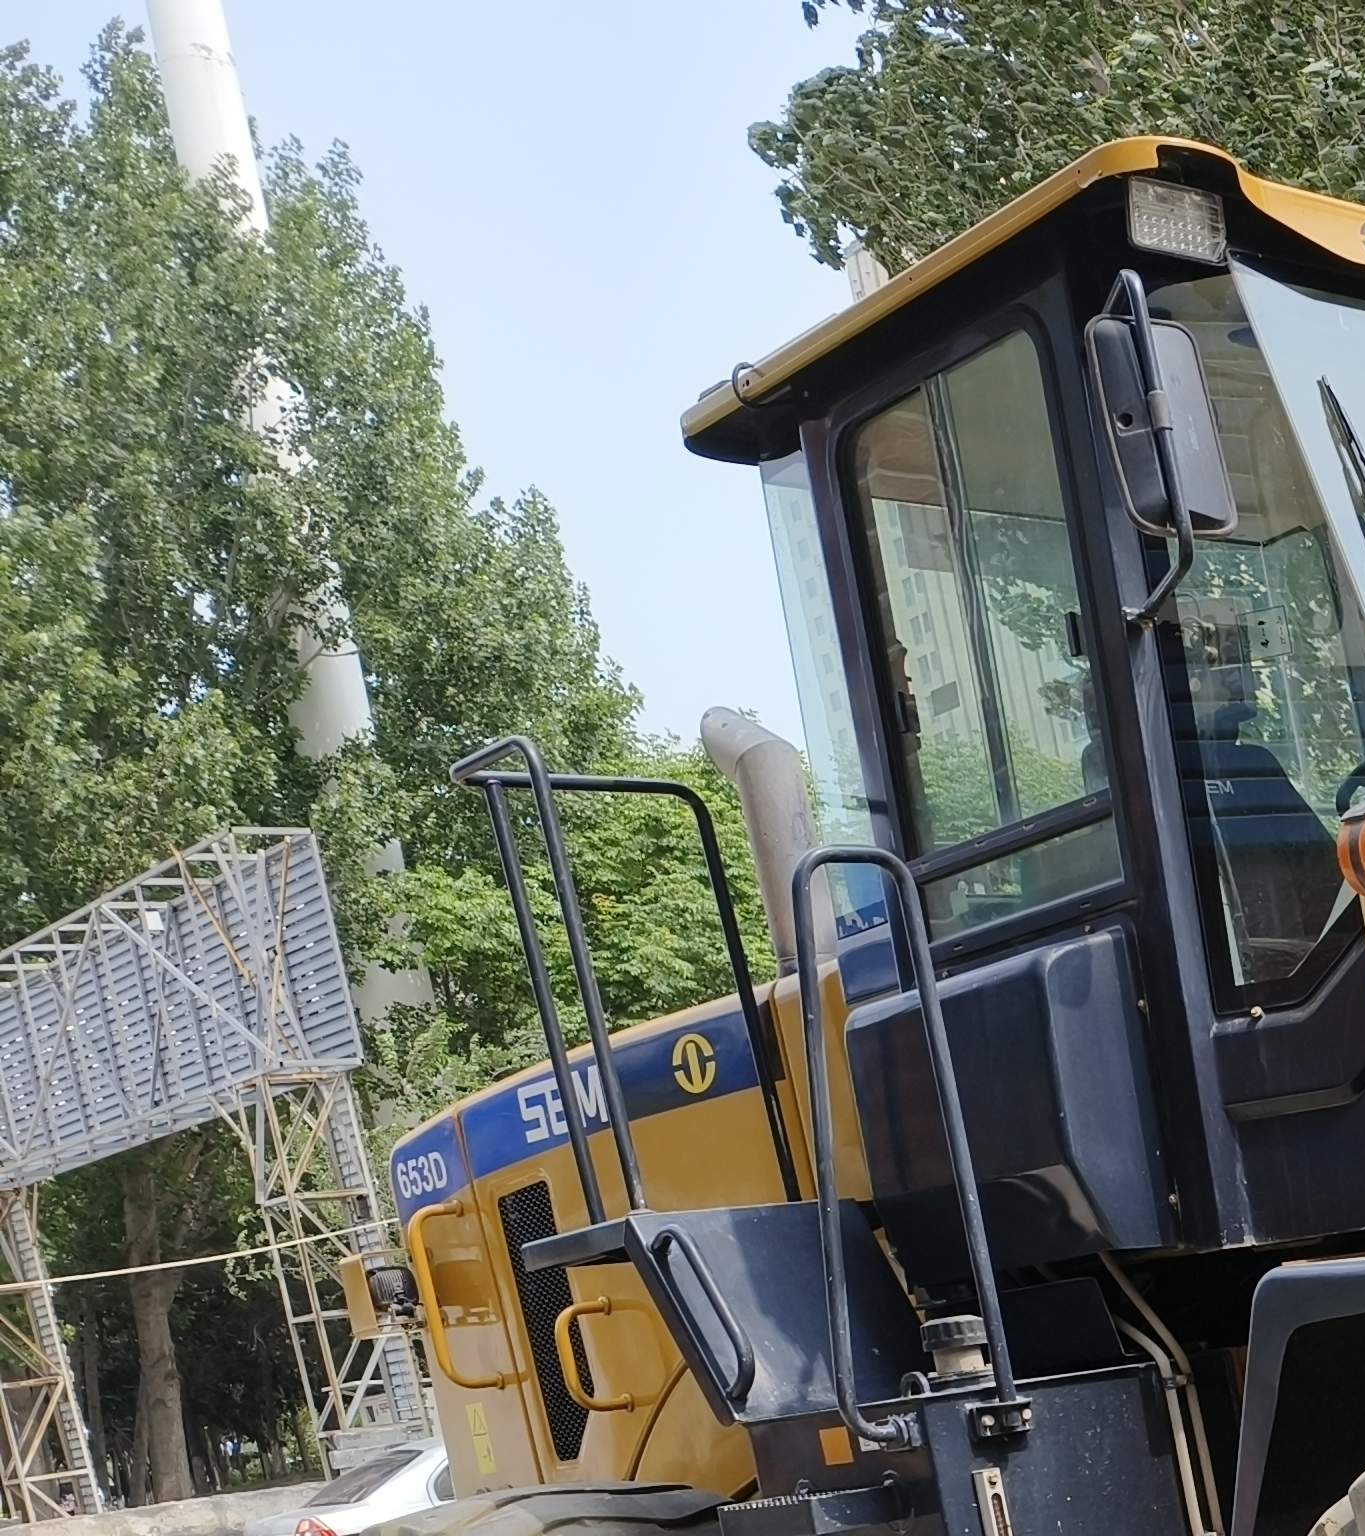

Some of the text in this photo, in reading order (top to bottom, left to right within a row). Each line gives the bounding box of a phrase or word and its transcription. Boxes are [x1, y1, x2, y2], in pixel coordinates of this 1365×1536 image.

[1204, 780, 1234, 795] EM
[517, 1065, 608, 1143] SEM
[397, 1152, 448, 1199] 653D
